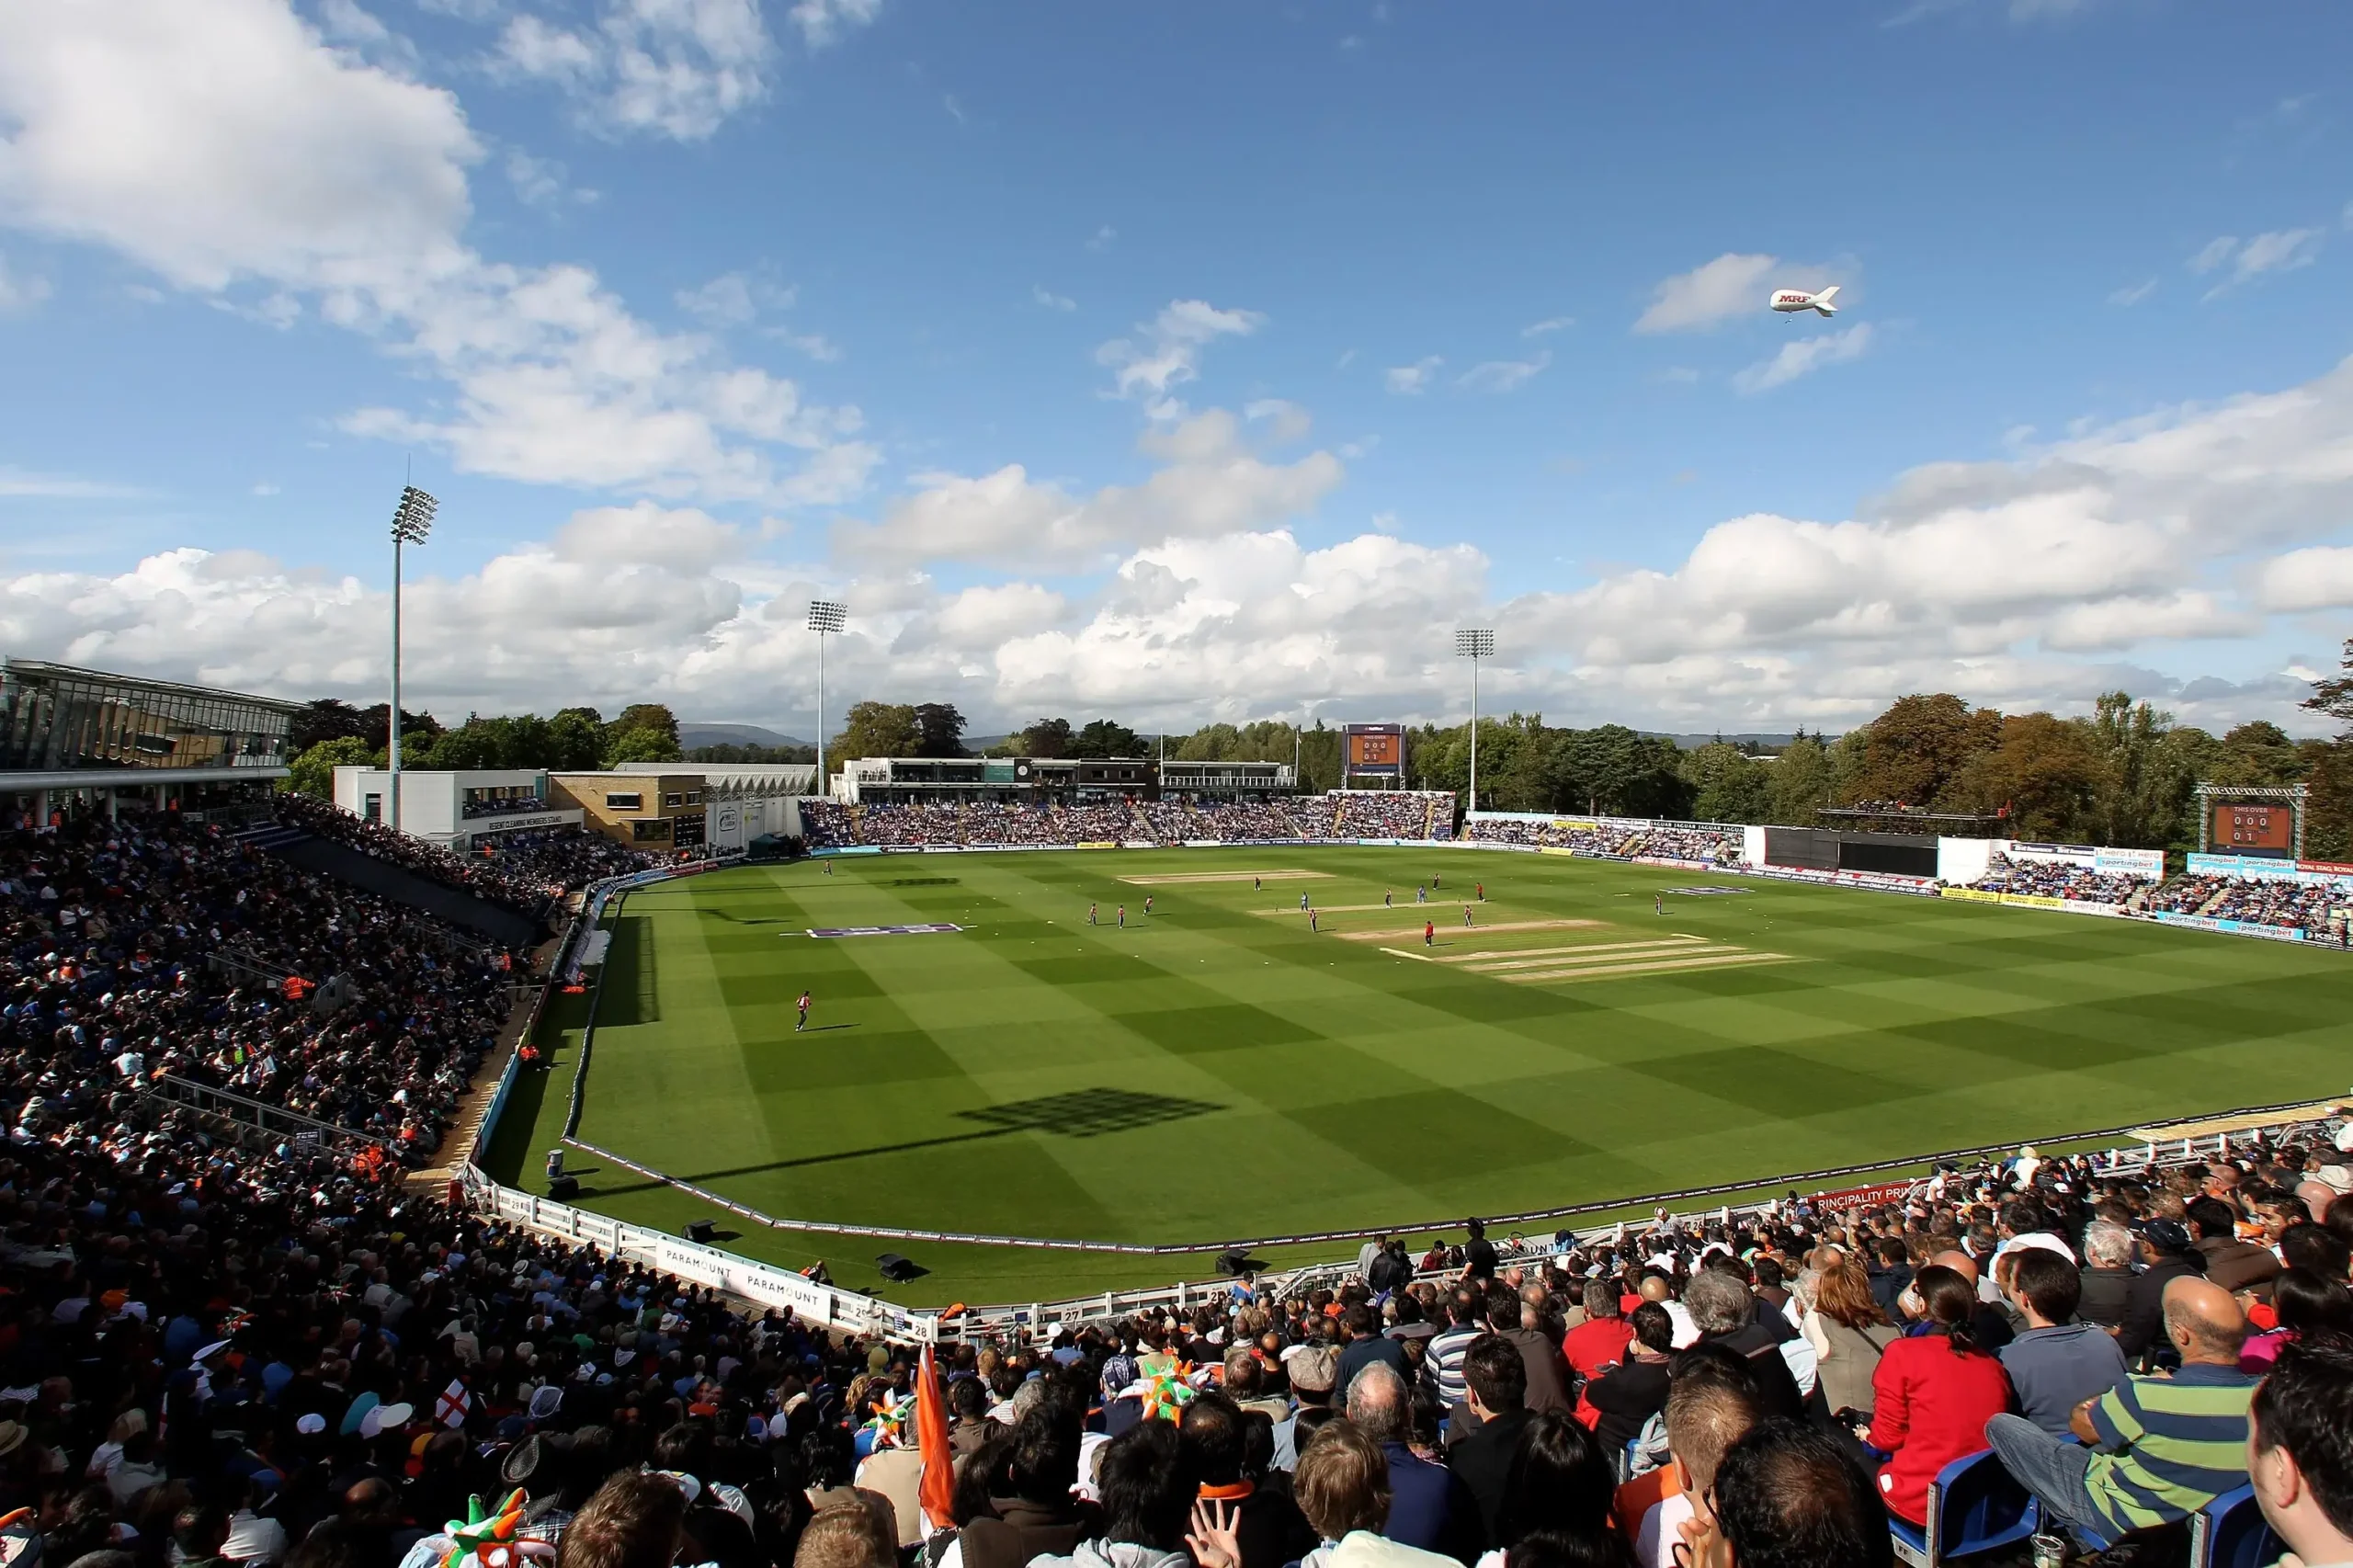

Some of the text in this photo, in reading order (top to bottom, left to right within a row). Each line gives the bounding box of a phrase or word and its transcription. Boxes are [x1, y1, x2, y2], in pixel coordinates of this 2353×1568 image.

[2192, 856, 2237, 864] sportingbet
[2165, 915, 2217, 927] sportingbet
[2236, 924, 2292, 937] sportingbet
[2315, 932, 2342, 942] KSK
[512, 1201, 519, 1210] 29
[1818, 1191, 1882, 1210] RINCIPALITY
[666, 1250, 731, 1278] PARAMOUNT
[1346, 1273, 1358, 1282] 26
[747, 1276, 818, 1305] PARAMOUNT
[1065, 1311, 1079, 1321] 27
[915, 1326, 927, 1337] 28
[1898, 1545, 1908, 1555] FF
